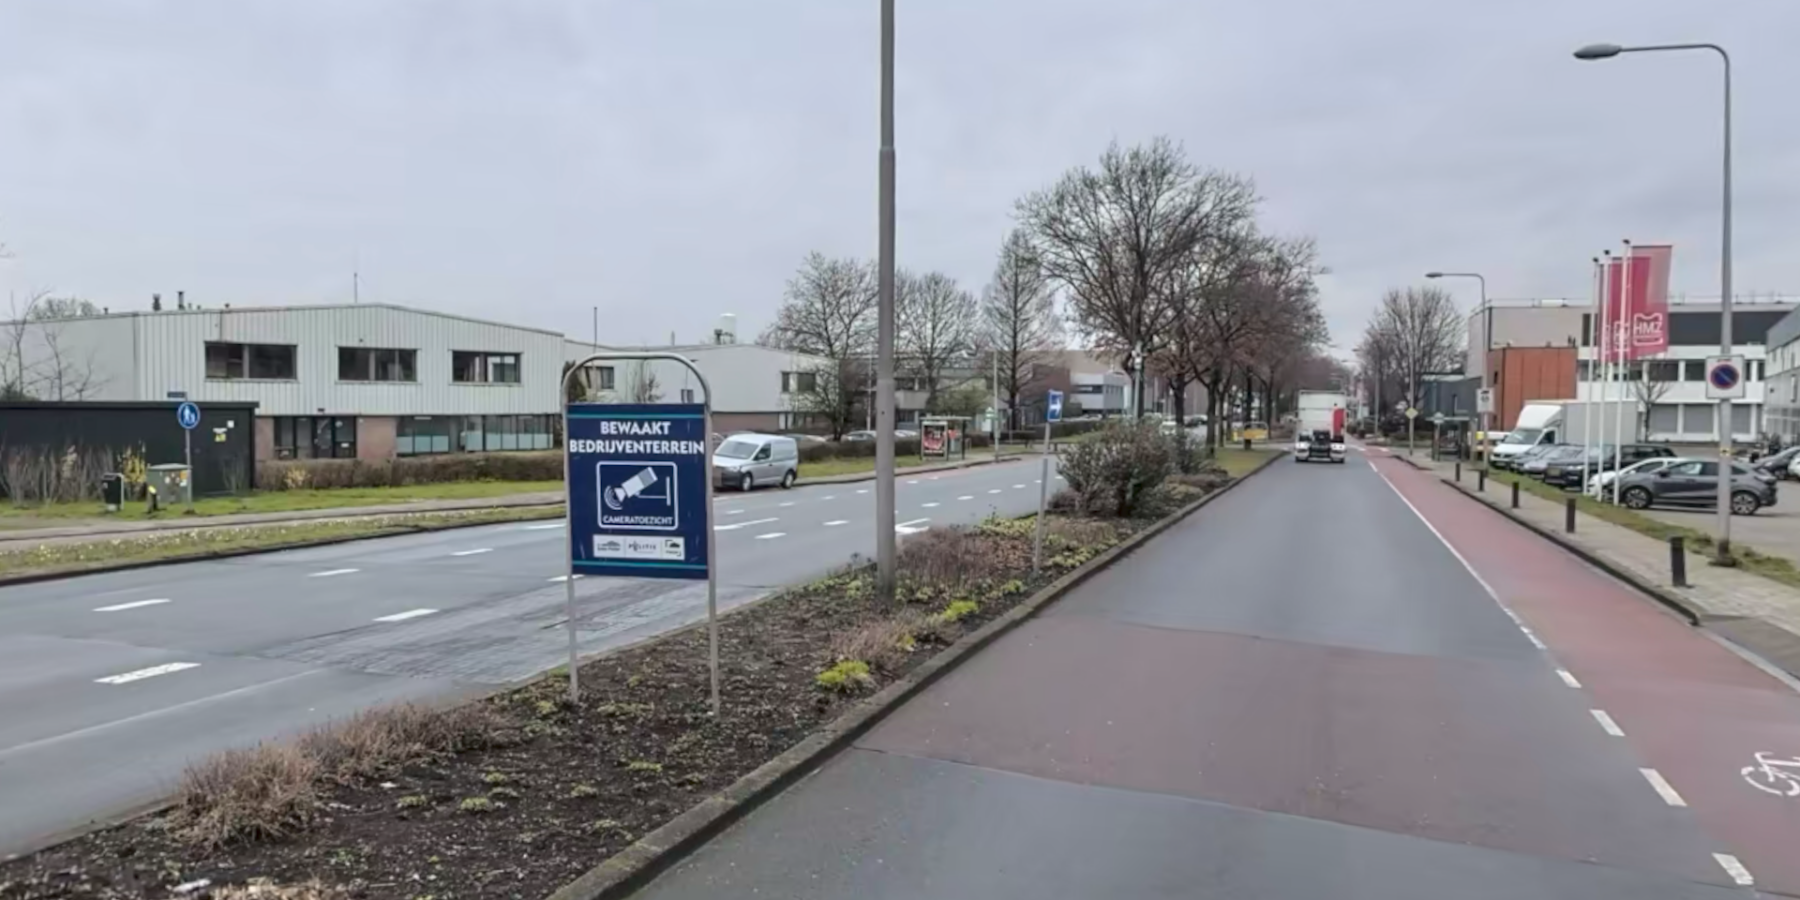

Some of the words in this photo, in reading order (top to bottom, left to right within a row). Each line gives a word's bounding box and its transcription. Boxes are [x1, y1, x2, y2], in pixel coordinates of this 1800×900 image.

[1634, 321, 1662, 335] HMZ
[600, 421, 671, 435] BEWAAKT
[569, 439, 705, 454] BEDRIJVENTERREIN
[602, 515, 674, 525] CAMERATOEZICHT
